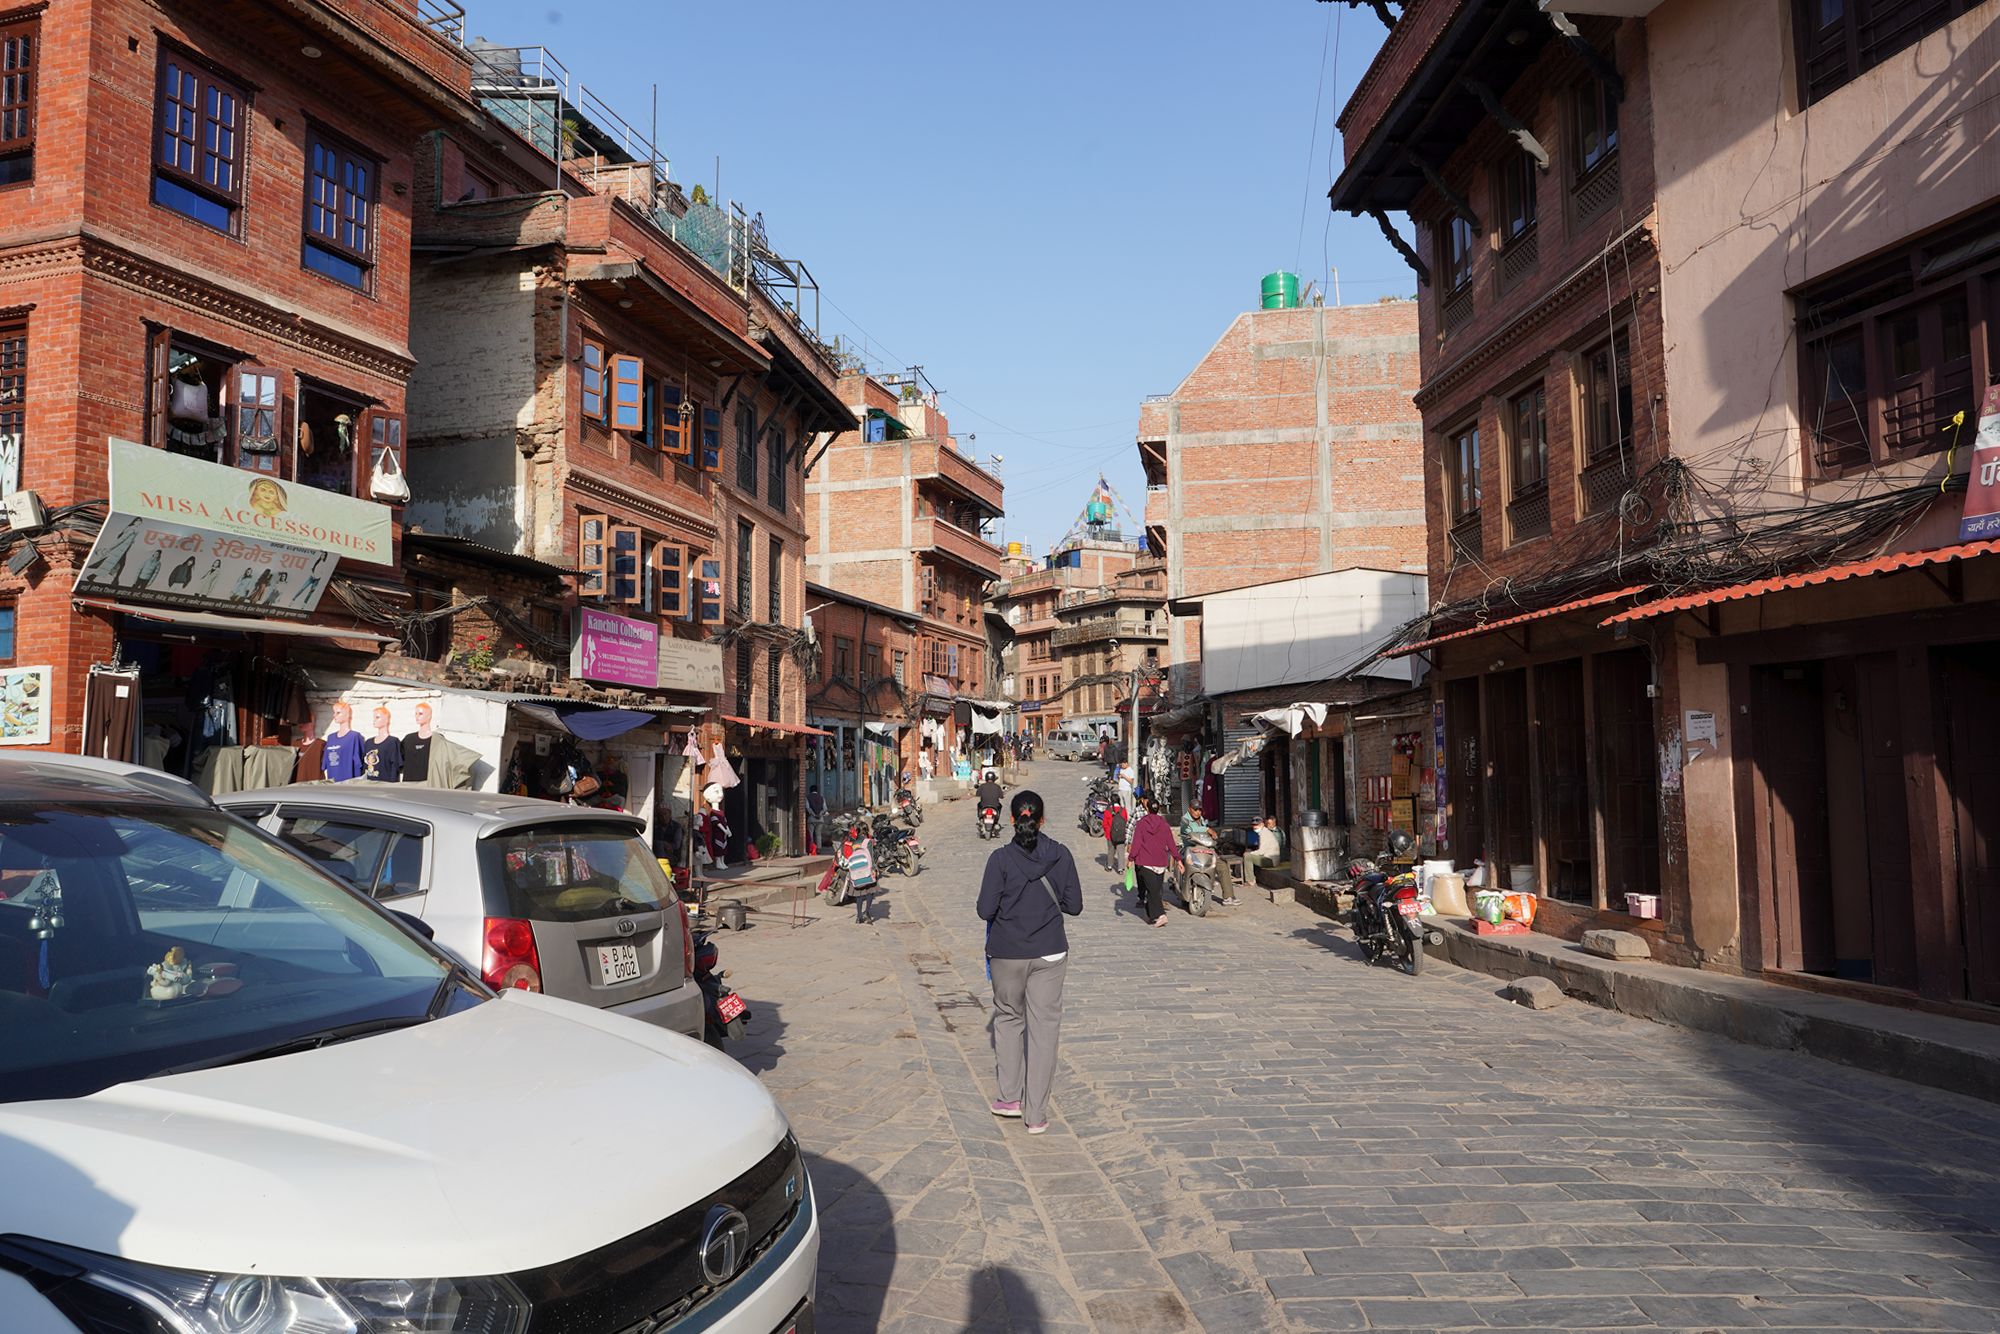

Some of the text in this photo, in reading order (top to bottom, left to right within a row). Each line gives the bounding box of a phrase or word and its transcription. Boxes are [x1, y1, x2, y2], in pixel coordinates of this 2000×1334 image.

[139, 490, 210, 518] MISA
[220, 506, 376, 553] ACCESSORIES
[212, 537, 273, 564] रेडिमेड
[281, 552, 310, 570] शप
[587, 615, 654, 642] Kanchhi Collection
[611, 945, 634, 963] B AC
[614, 961, 637, 979] 0902
